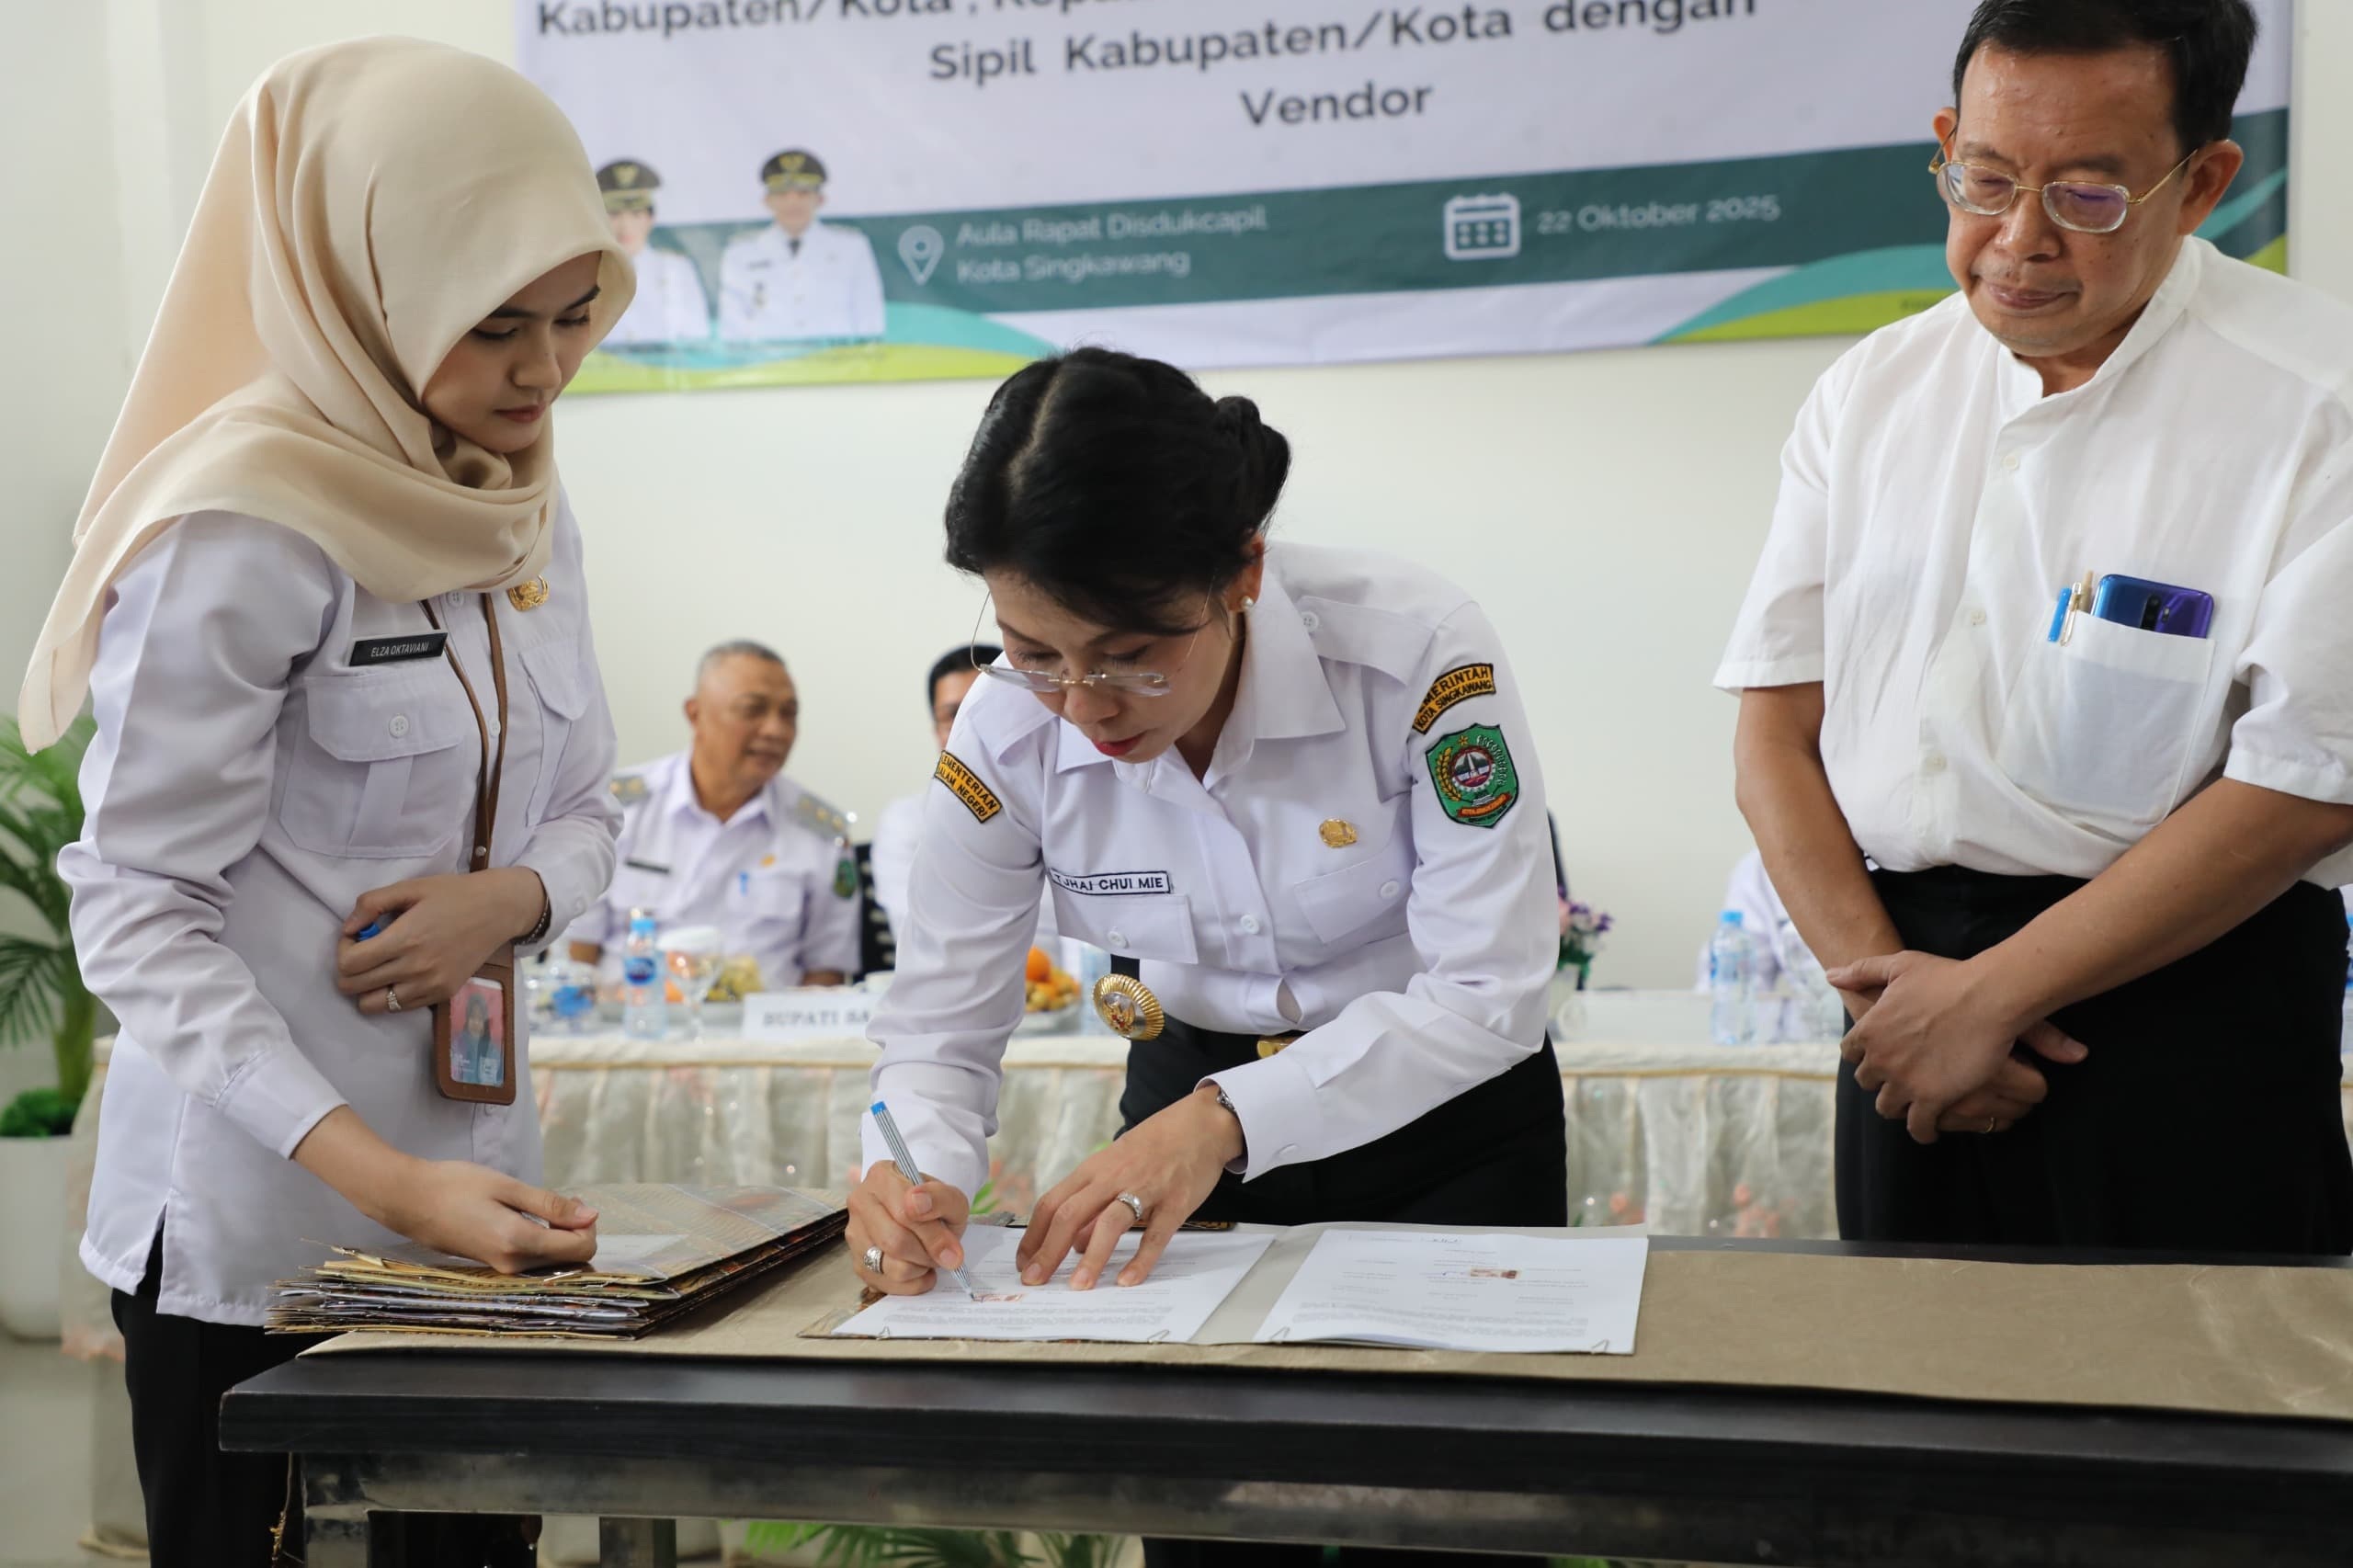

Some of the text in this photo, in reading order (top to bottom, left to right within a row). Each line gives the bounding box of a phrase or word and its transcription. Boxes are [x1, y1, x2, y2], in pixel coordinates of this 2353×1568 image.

[930, 0, 1756, 88] Sipil Kabupaten/Kota dengan
[1239, 80, 1433, 127] Vendor
[956, 205, 1267, 245] Aula Rapat Disdukcapil
[1537, 194, 1781, 235] 22 Oktober 2025
[956, 251, 1191, 284] Kota Singkawang
[370, 642, 430, 658] ELZA OKTAVIANI
[1415, 680, 1493, 729] KOTA SINGKAWANG
[957, 784, 988, 817] NEGERI
[1098, 877, 1133, 891] CHUI
[1138, 877, 1164, 890] MIE
